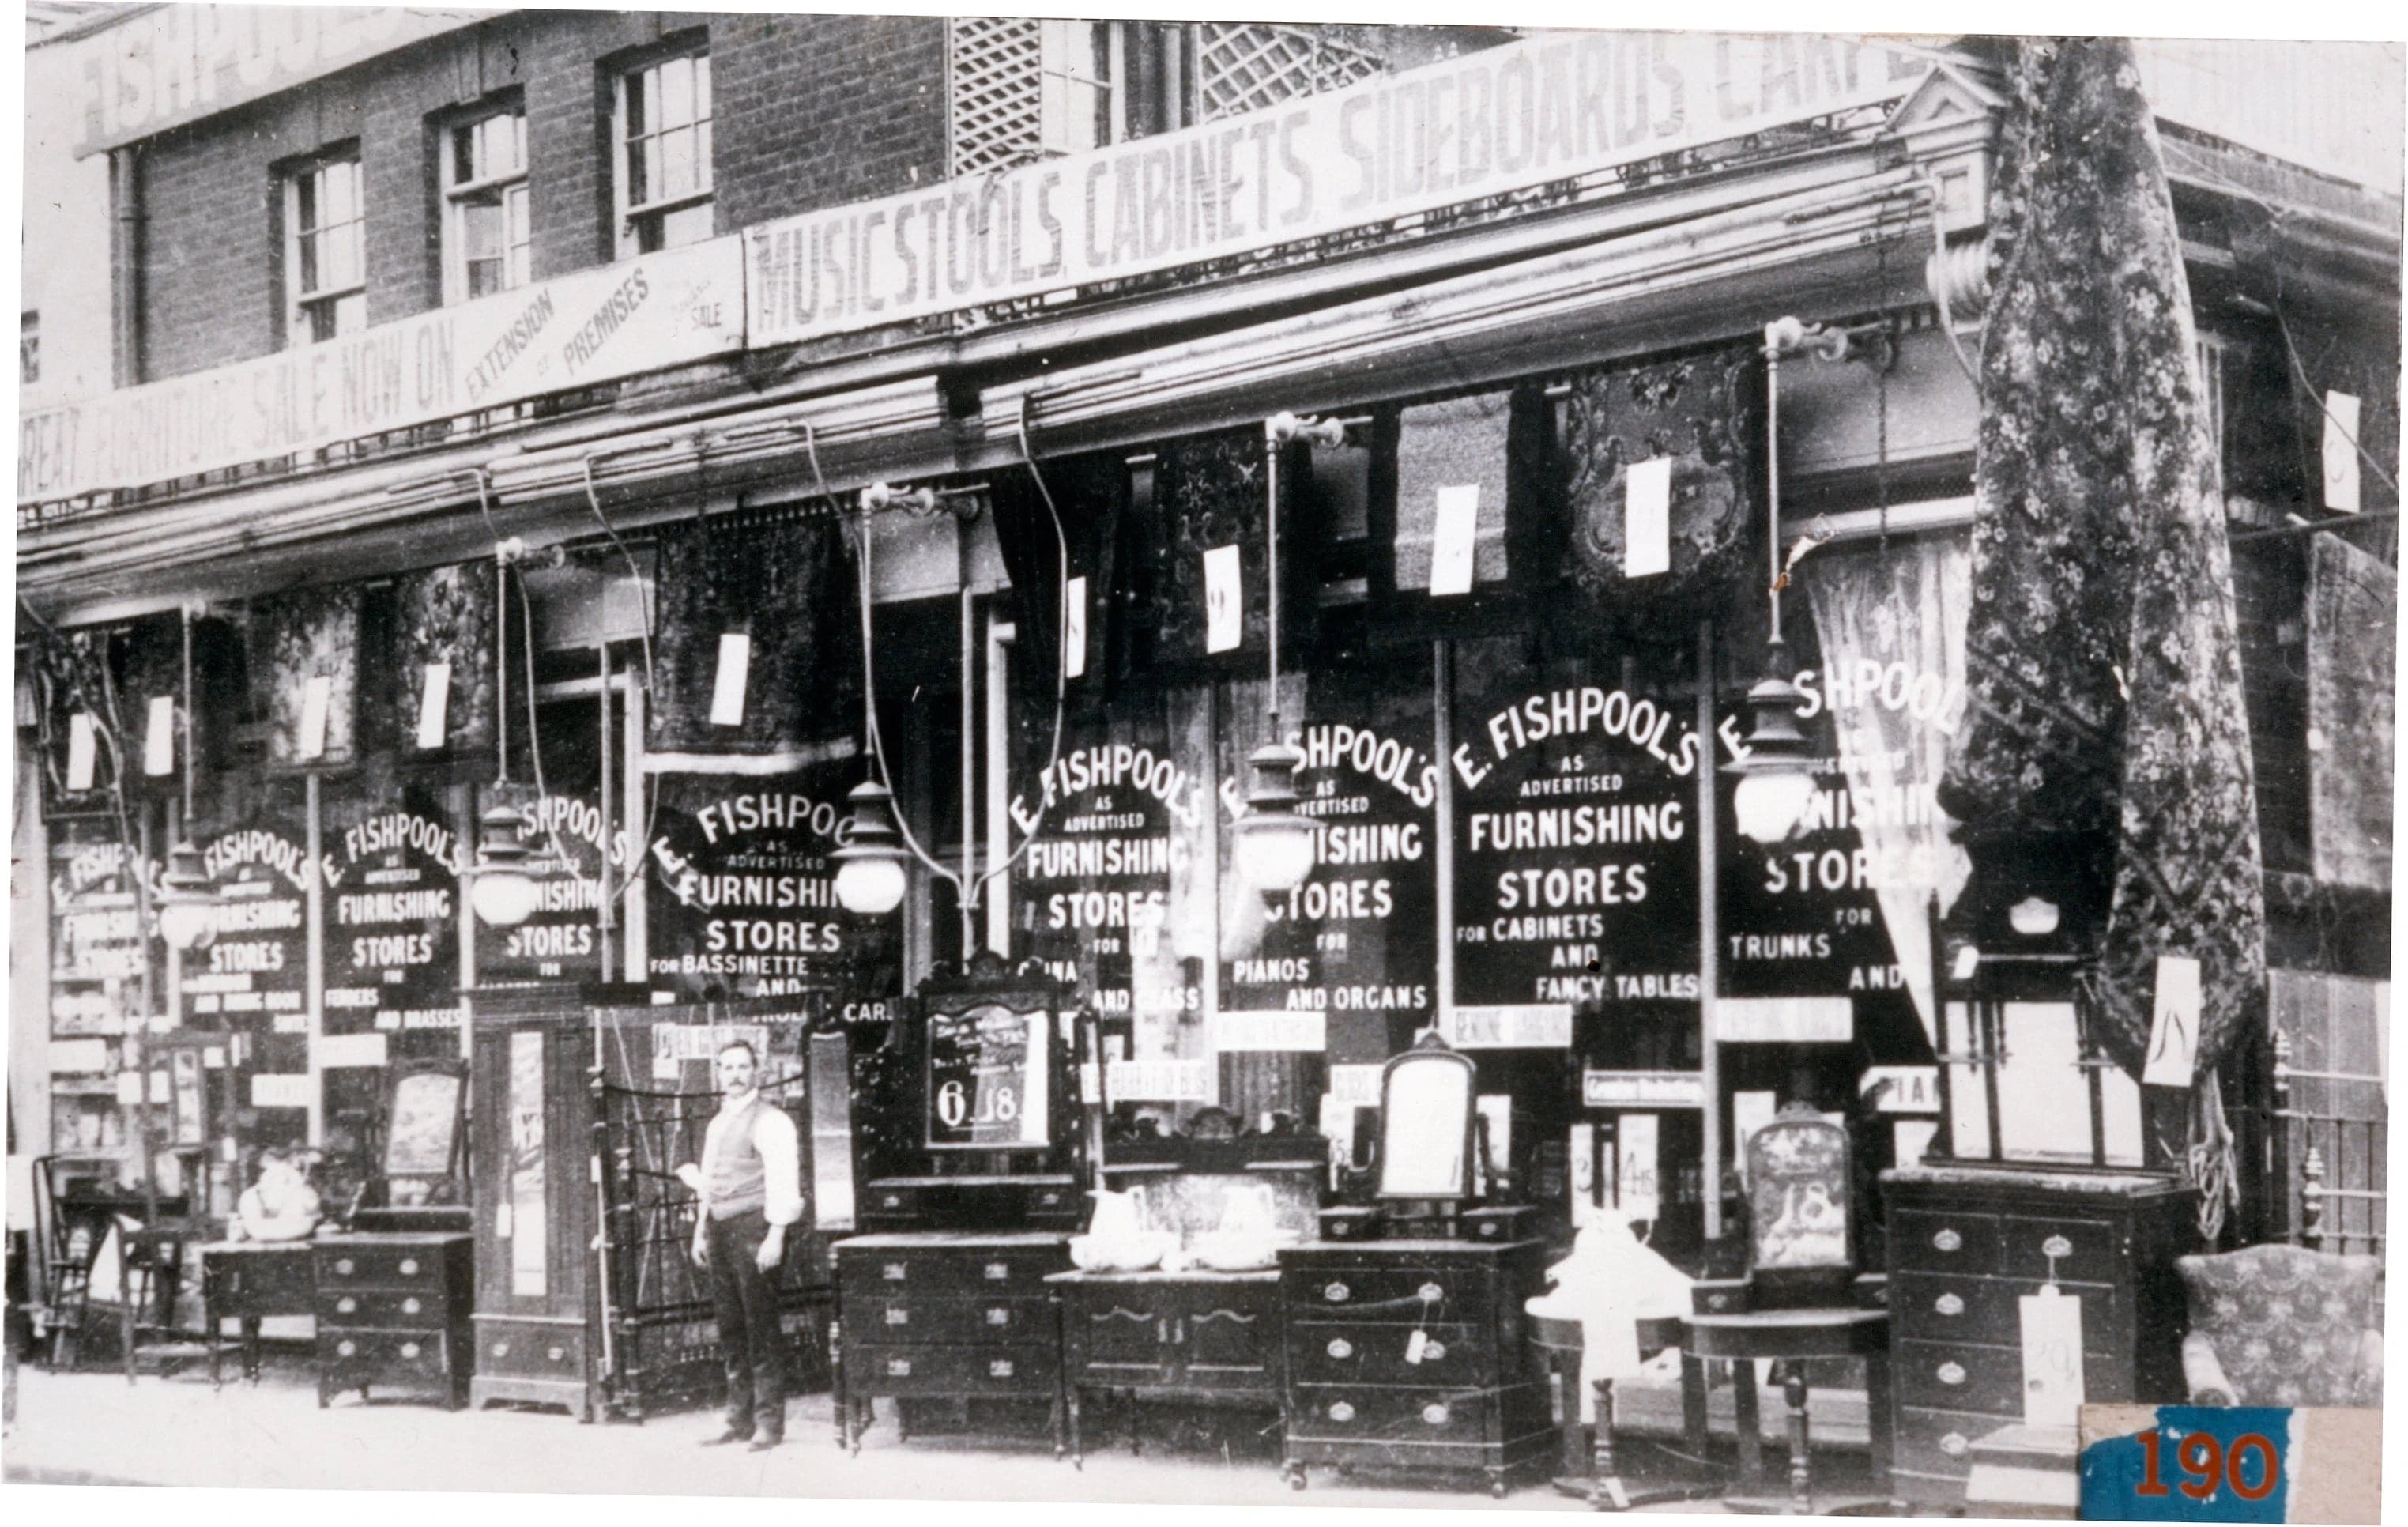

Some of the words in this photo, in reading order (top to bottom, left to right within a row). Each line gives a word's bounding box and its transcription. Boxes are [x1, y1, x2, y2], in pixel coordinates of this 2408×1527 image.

[756, 204, 887, 334] MUSIC
[562, 266, 650, 375] PREMISES
[691, 302, 722, 330] SALE
[465, 287, 555, 402] EXTENSION
[254, 353, 330, 449] SALE
[341, 328, 405, 428] NOW
[416, 315, 457, 409] ON
[1487, 686, 1701, 778] FISHPOOL'S
[1283, 724, 1441, 809] SHPOOL'S
[1559, 754, 1585, 774] AS
[1039, 743, 1204, 828] FISHPOOL'S
[1315, 779, 1336, 797] AS
[1519, 774, 1623, 797] ADVERTISED
[1095, 795, 1113, 812] AS
[696, 793, 857, 848] FISHPOO
[1064, 812, 1145, 833] ADVERTISED
[1470, 801, 1685, 853] FURNISHING
[345, 813, 464, 877] FISHPOOL'S
[766, 840, 789, 853] AS
[1027, 836, 1189, 880] FURNISHING
[726, 854, 827, 871] ADVERTISED
[679, 873, 841, 908] FURNISHI
[1498, 864, 1649, 911] STORES
[338, 888, 450, 924] FURNISHING
[1048, 892, 1166, 930] STORES
[1834, 909, 1872, 926] FOR
[507, 924, 593, 957] STORES
[706, 919, 842, 953] STORES
[1315, 933, 1348, 952] FOR
[1456, 926, 1487, 944] FOR
[1492, 913, 1604, 943] CABINETS
[209, 941, 283, 972] STORES
[352, 933, 433, 967] STORES
[1092, 937, 1121, 956] FOR
[1551, 944, 1600, 971] AND
[1731, 933, 1831, 960] TRUNKS
[650, 958, 680, 973] FOR
[682, 953, 809, 975] BASSINETTE
[1233, 956, 1310, 984] PIANOS
[1849, 964, 1906, 991] AND
[756, 978, 802, 998] AND
[1091, 989, 1131, 1012] AND
[1284, 985, 1328, 1012] AND
[1332, 984, 1428, 1011] ORGANS
[1536, 974, 1609, 1001] FANCY
[1615, 972, 1701, 1001] TABLES
[375, 1009, 401, 1029] AND
